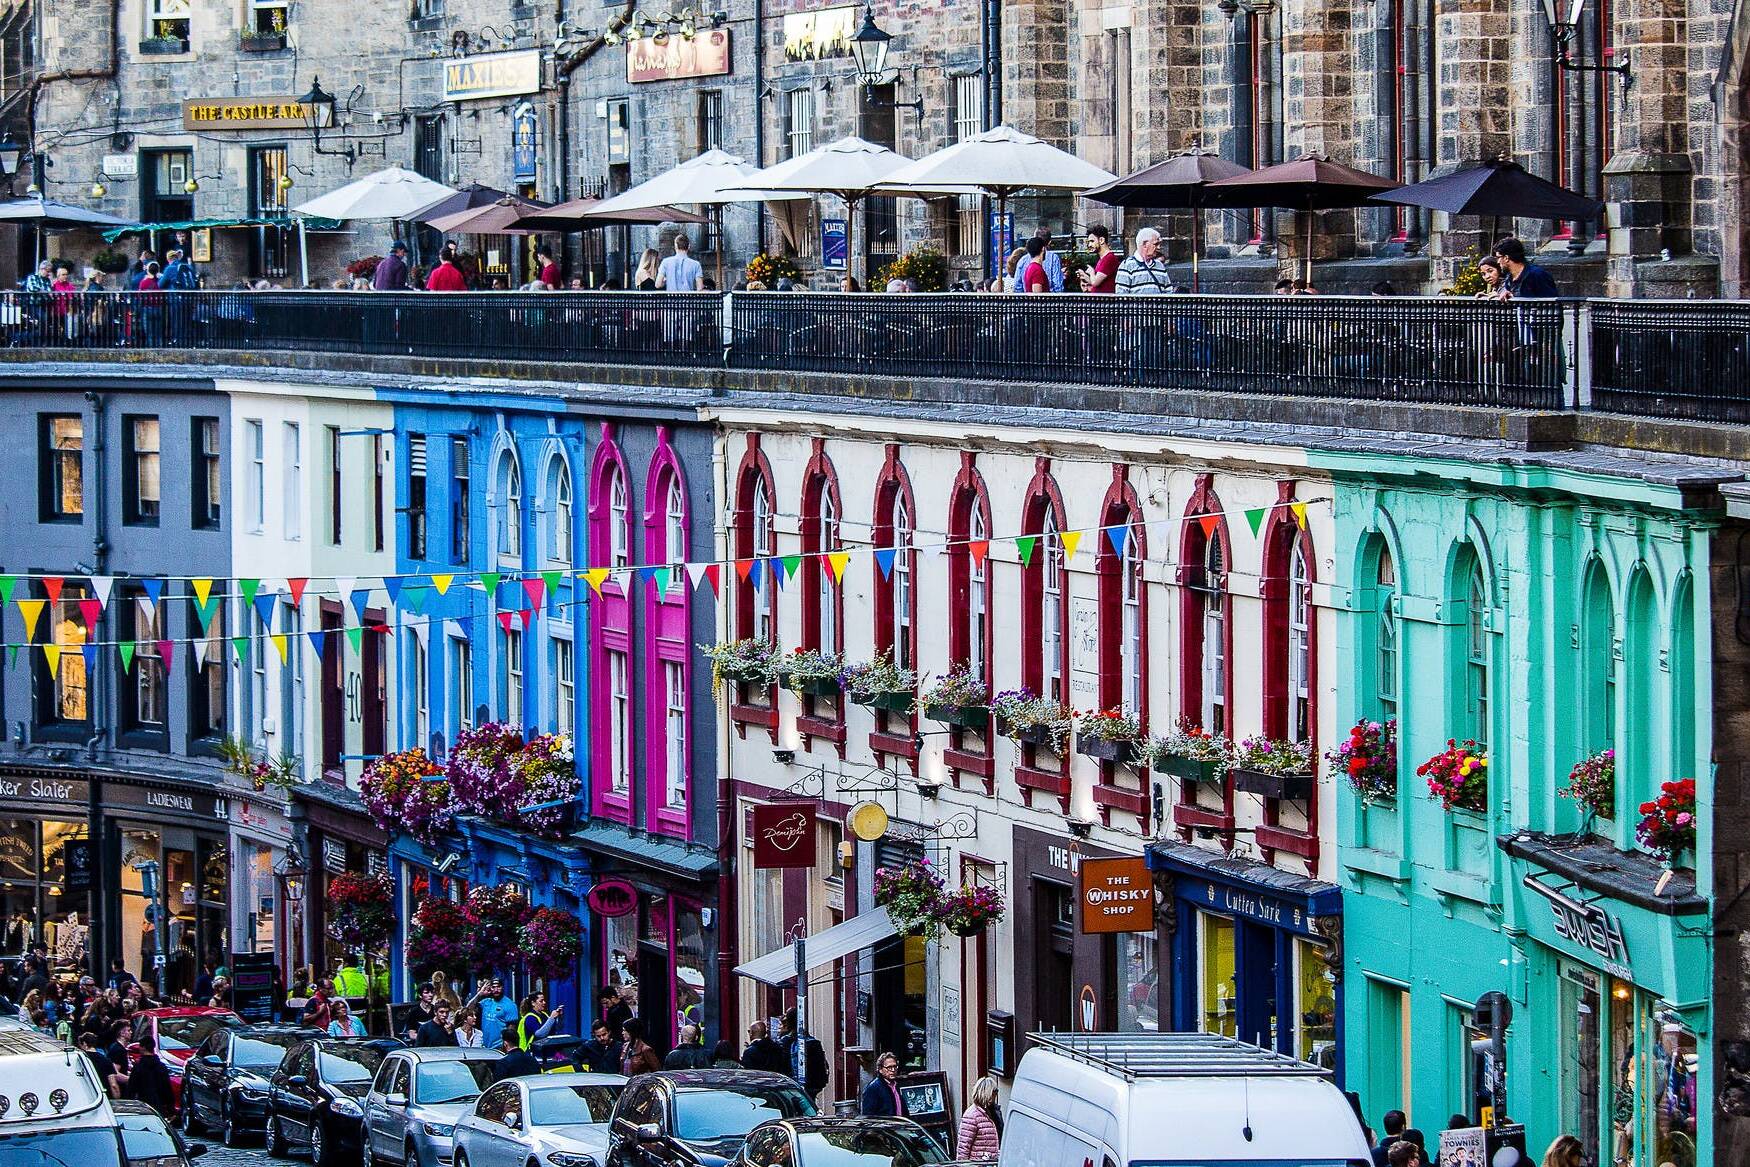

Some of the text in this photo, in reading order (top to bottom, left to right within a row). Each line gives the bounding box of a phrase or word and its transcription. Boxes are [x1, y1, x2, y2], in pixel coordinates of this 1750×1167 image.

[346, 671, 363, 723] 40
[30, 778, 73, 799] Slater
[147, 791, 193, 811] LADIESWEAR
[214, 799, 228, 819] 44
[1048, 845, 1069, 870] THE
[1106, 876, 1130, 885] THE
[1087, 889, 1150, 904] WHISKY
[1103, 906, 1134, 915] SHOP
[1258, 895, 1280, 923] Sark
[1444, 1138, 1481, 1148] TOWNIES
